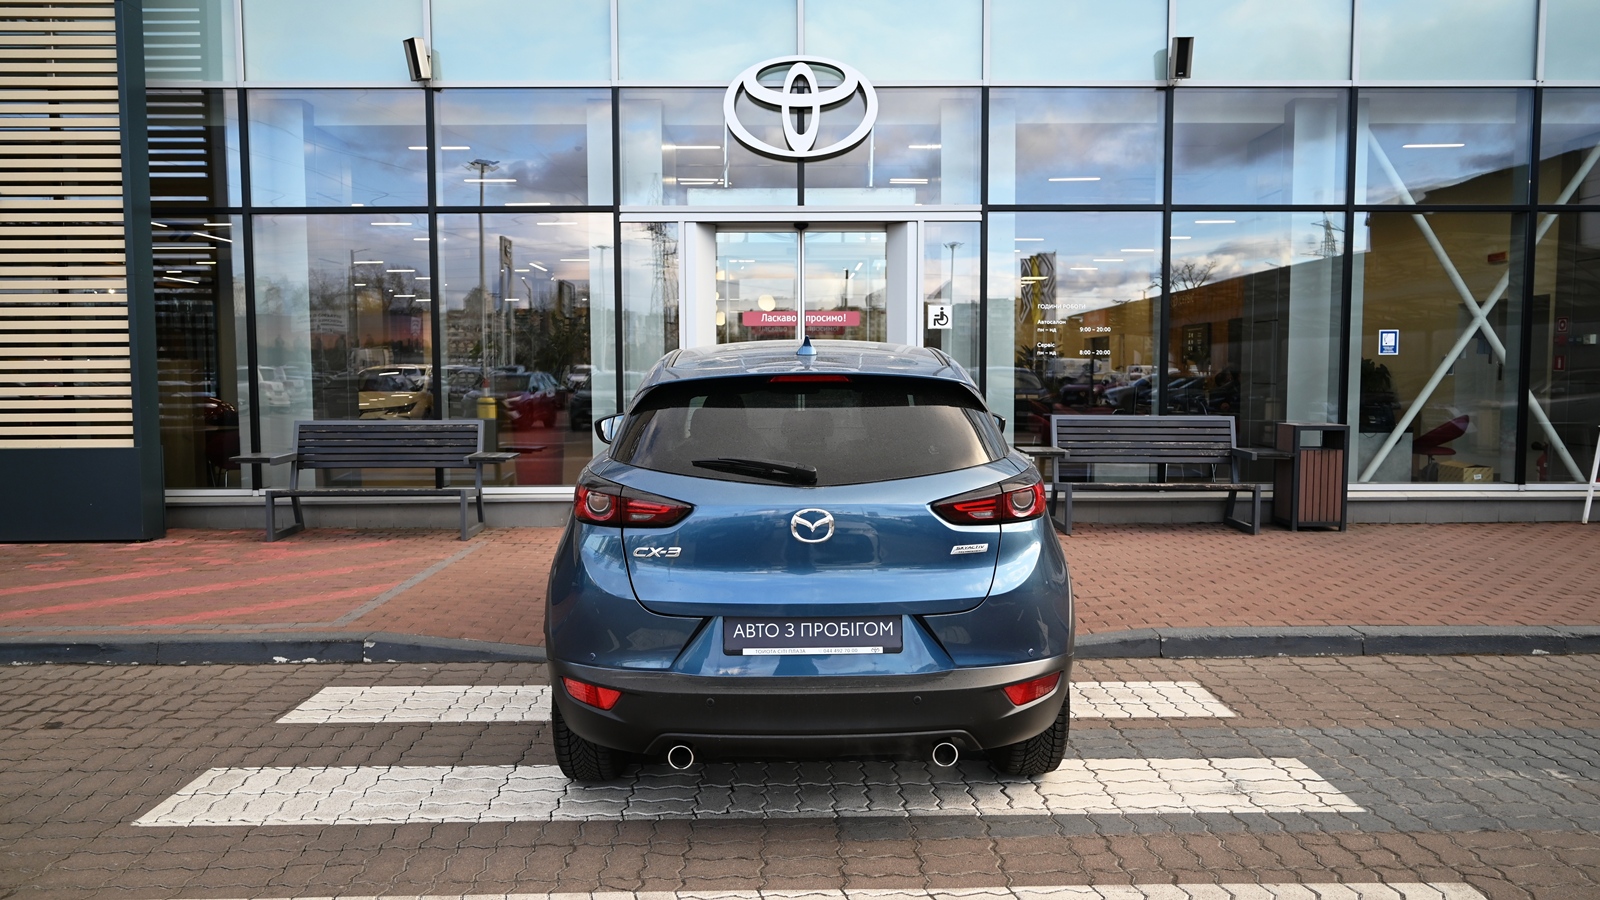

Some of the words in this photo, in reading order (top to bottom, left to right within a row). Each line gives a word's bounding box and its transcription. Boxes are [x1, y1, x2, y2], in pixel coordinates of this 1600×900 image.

[760, 313, 797, 322] Ласкаво
[805, 313, 847, 324] просимо!
[632, 546, 682, 558] CX-3
[733, 622, 780, 639] АВТО
[800, 621, 894, 638] ПРОБІГОМ
